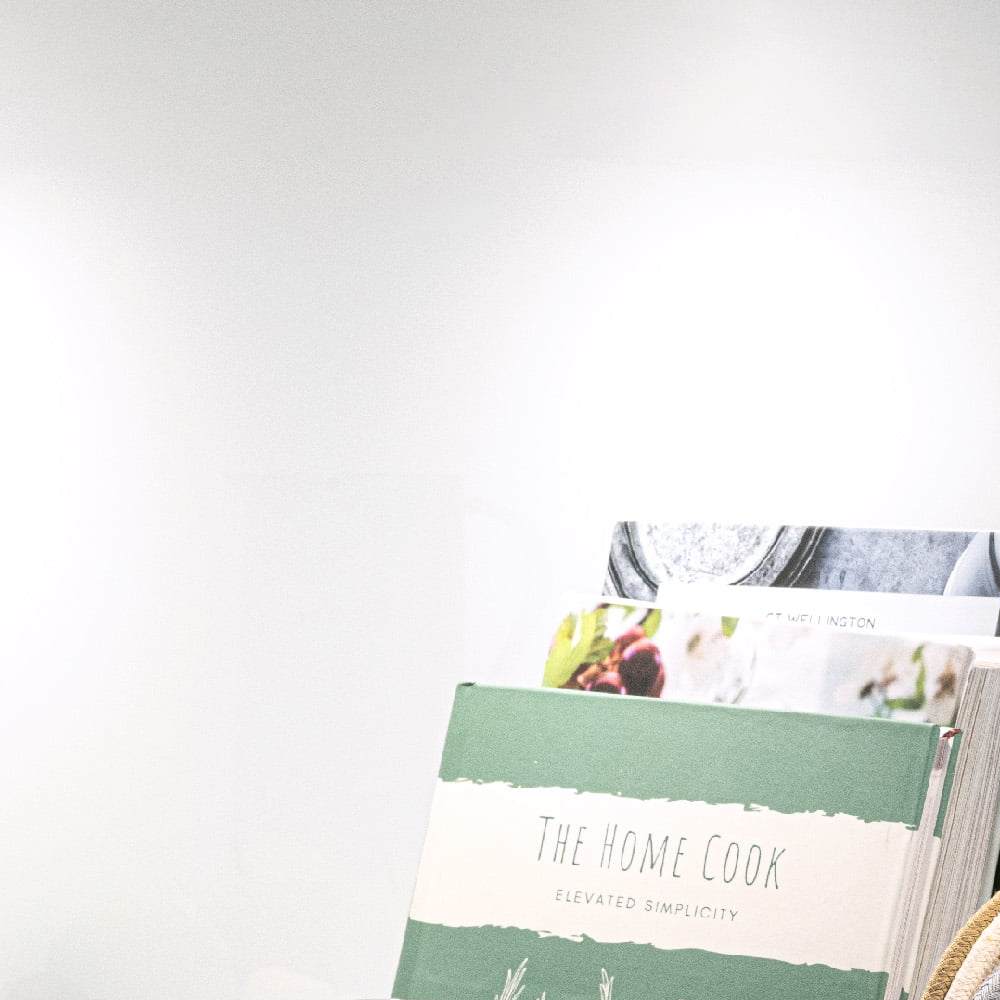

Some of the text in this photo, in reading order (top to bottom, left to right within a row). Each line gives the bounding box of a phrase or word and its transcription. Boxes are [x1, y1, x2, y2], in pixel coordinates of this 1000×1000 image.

[537, 815, 786, 890] THE HOME COOK
[555, 889, 738, 922] ELEVATED SIMPLICITY
